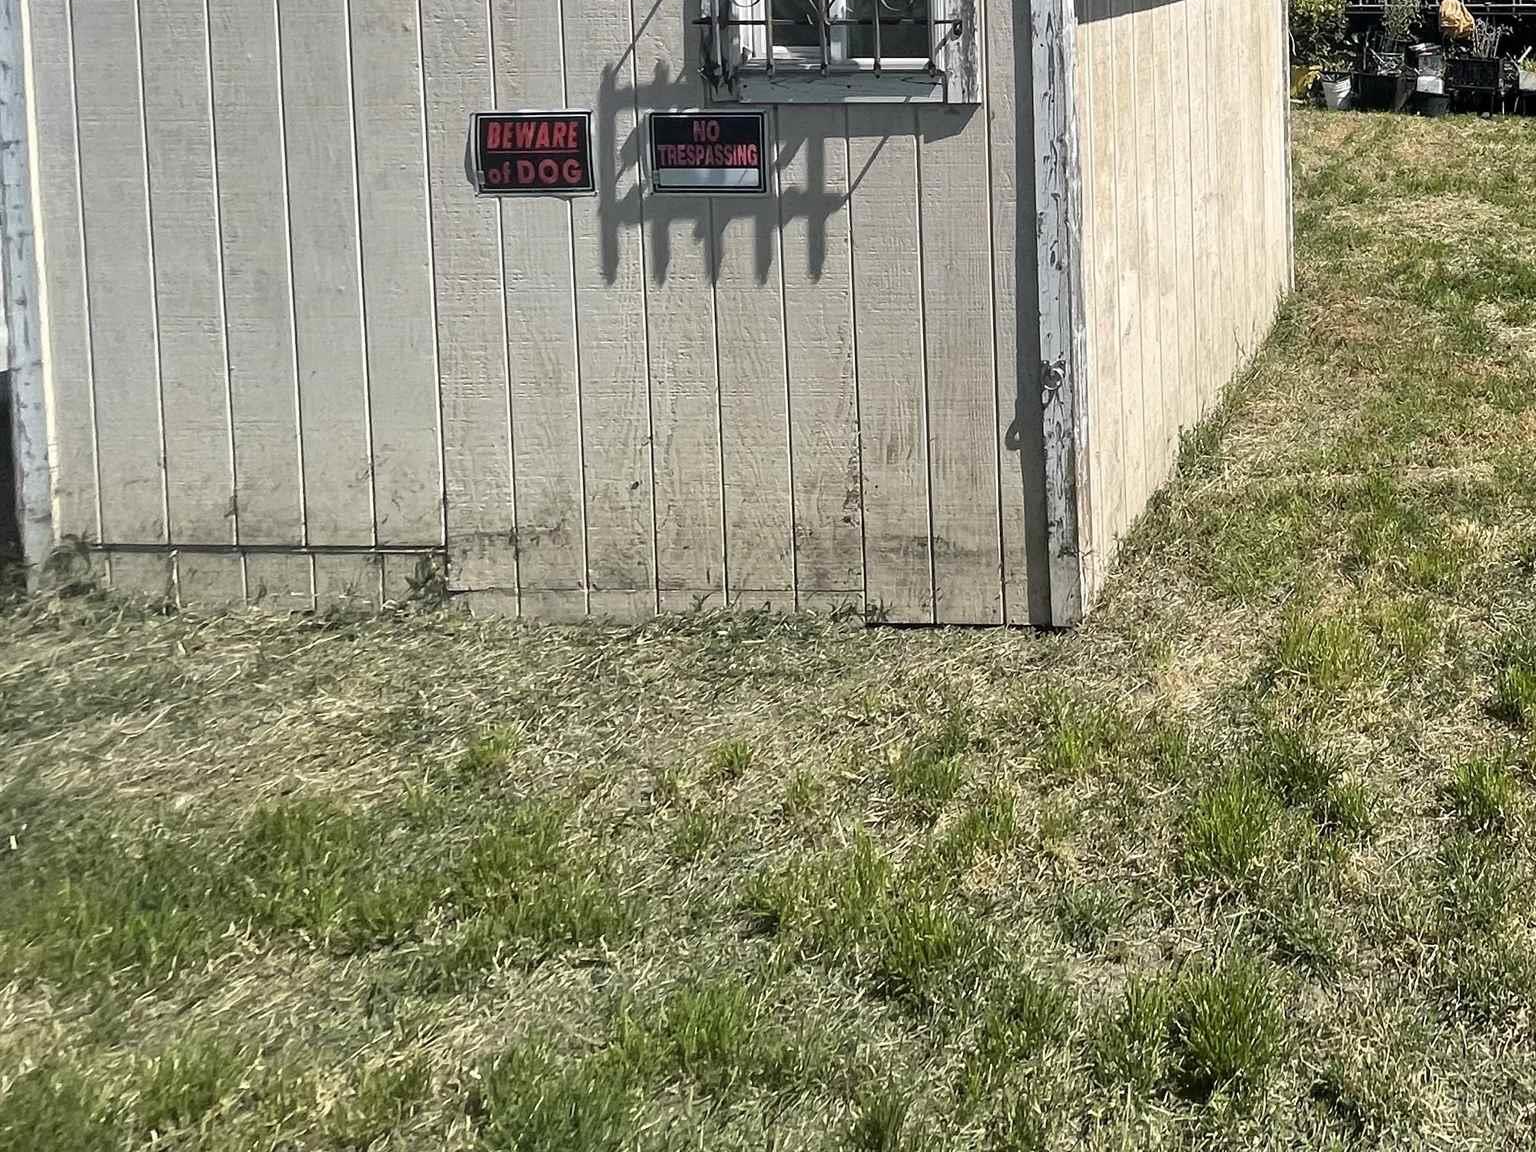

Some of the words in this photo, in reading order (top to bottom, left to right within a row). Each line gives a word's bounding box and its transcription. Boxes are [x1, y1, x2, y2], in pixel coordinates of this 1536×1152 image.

[487, 121, 578, 148] BEWARE
[693, 120, 720, 142] NO
[657, 144, 758, 166] TRESPASSING
[487, 161, 511, 184] of
[516, 159, 582, 184] DOG
